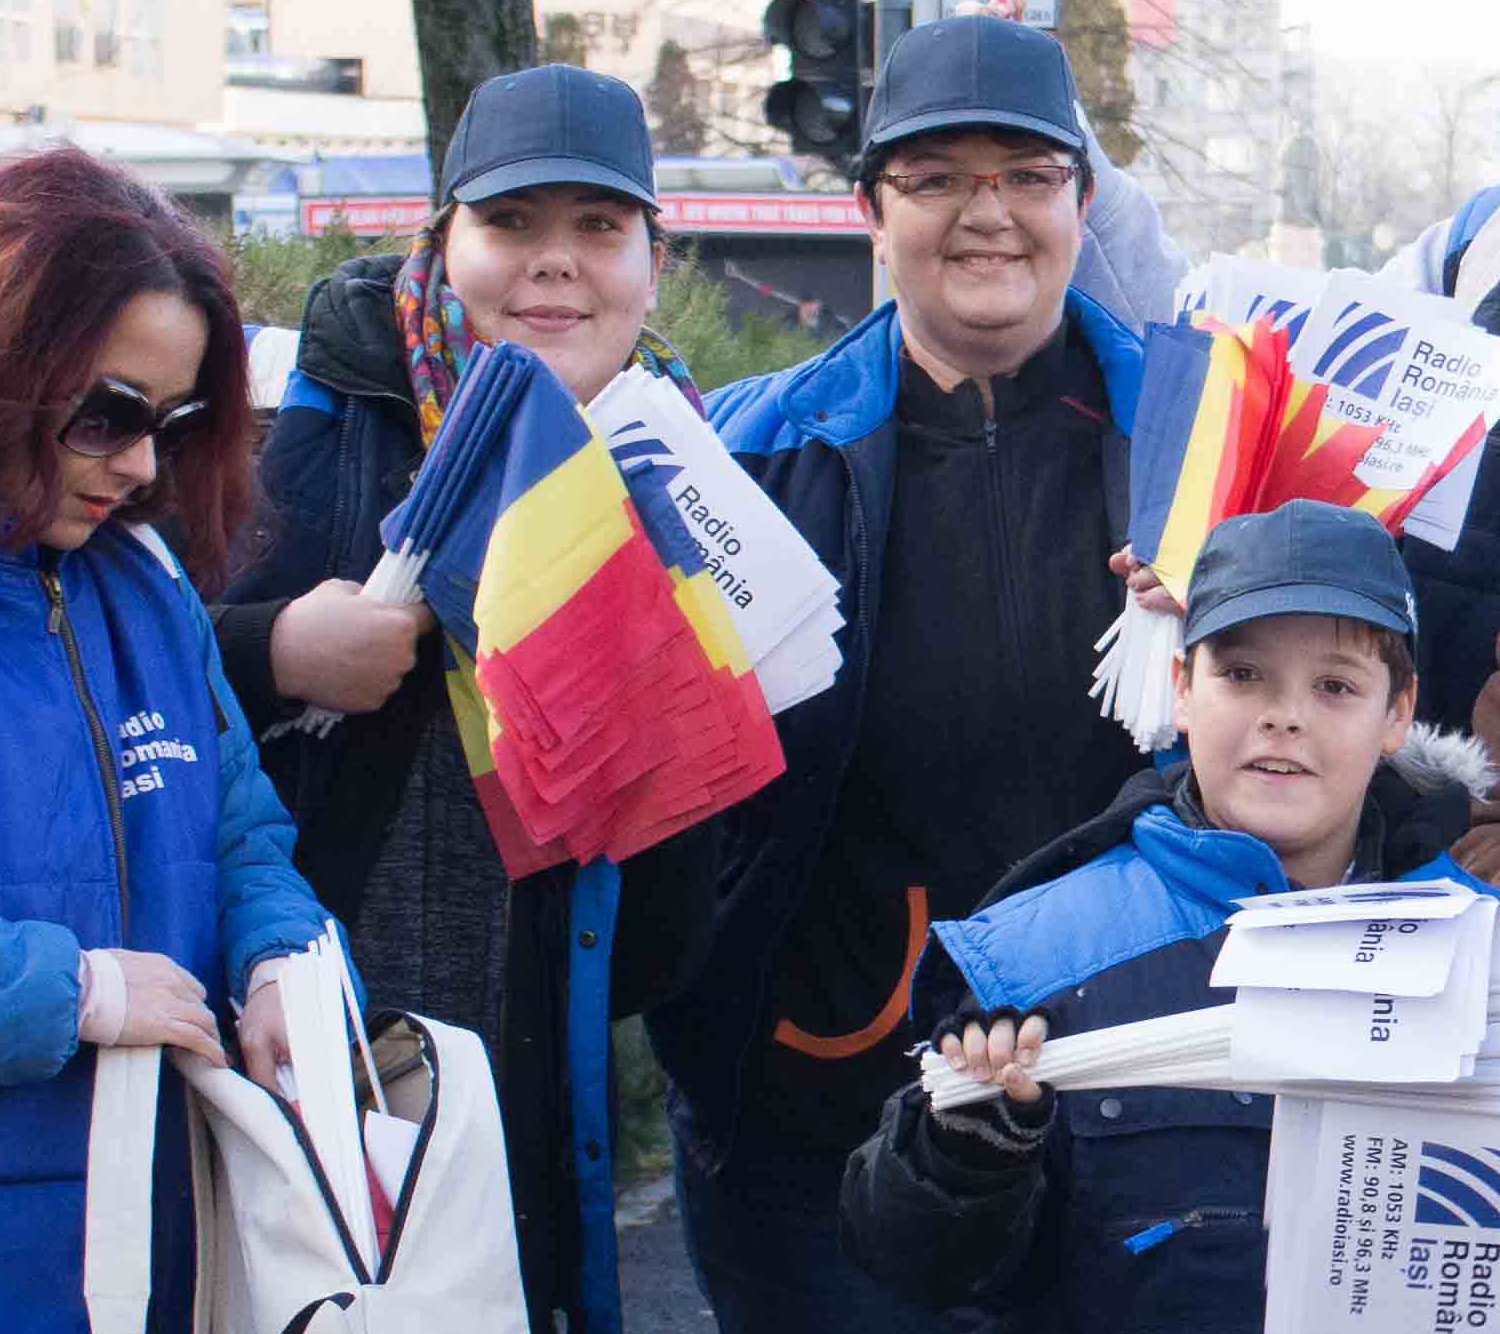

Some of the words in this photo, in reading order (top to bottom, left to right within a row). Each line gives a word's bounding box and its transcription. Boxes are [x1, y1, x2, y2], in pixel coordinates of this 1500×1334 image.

[1412, 340, 1483, 378] Radio
[676, 485, 740, 555] Radio
[119, 711, 165, 738] adio
[122, 765, 164, 798] asi
[1366, 1136, 1383, 1170] FM:
[1389, 1138, 1409, 1175] AM:
[1329, 1134, 1357, 1287] www.radioiasi.ro
[1360, 1177, 1379, 1215] 90,8
[1385, 1184, 1405, 1223] 1053
[1353, 1239, 1373, 1274] 96,3
[1381, 1230, 1400, 1261] KHz
[1400, 1238, 1438, 1290] Iași
[1349, 1279, 1370, 1316] MHz
[1467, 1243, 1500, 1328] Radio
